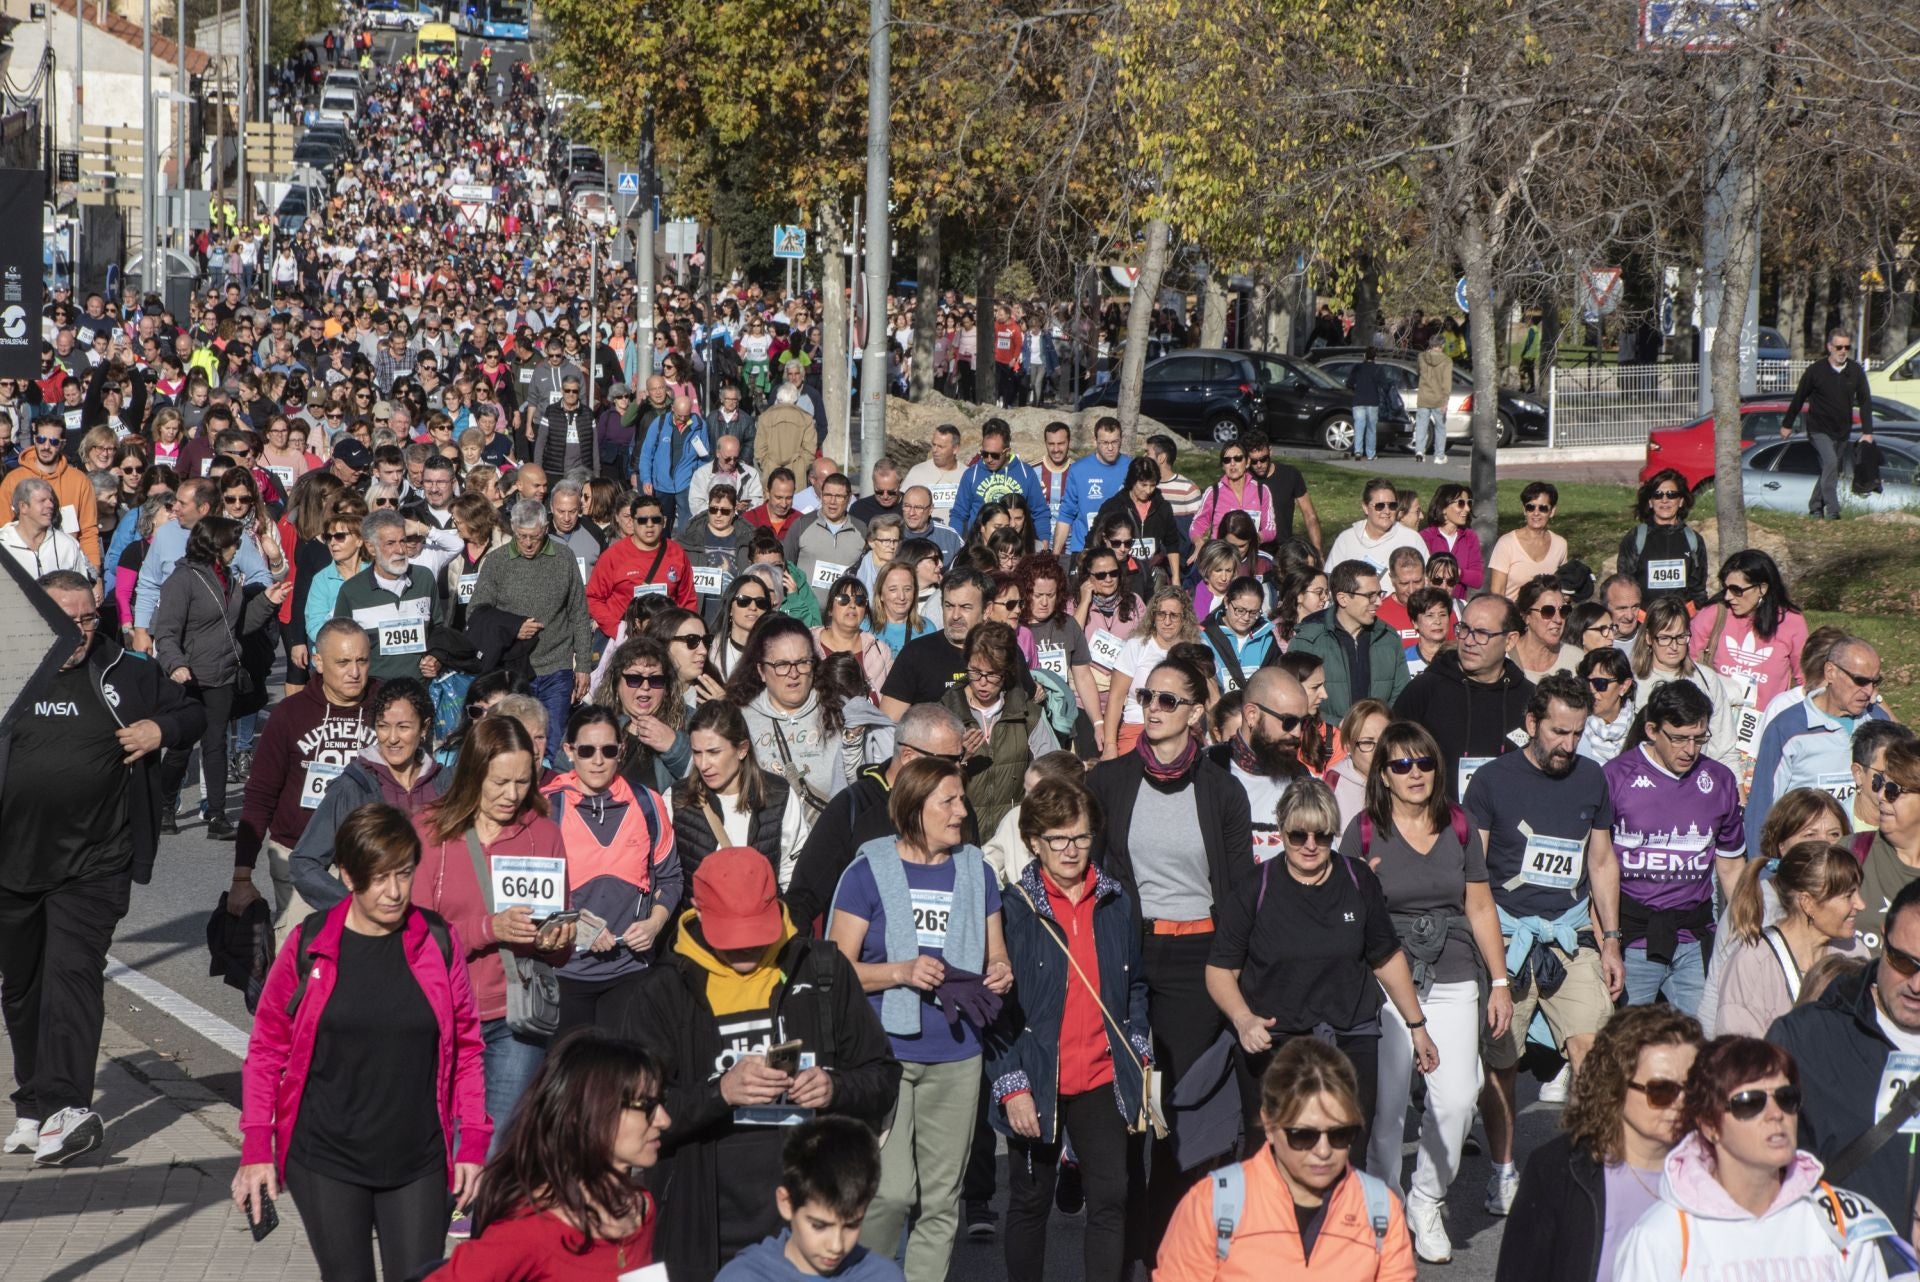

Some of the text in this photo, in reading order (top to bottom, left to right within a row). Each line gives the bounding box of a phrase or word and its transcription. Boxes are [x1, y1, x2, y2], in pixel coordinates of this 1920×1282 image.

[933, 491, 956, 501] 6755
[694, 575, 715, 587] 2714
[1653, 568, 1680, 581] 4946
[460, 583, 476, 596] 26
[385, 629, 418, 646] 2994
[35, 701, 79, 717] NASA
[1738, 712, 1757, 744] 1098
[324, 741, 348, 749] DENIM
[1532, 852, 1573, 876] 4724
[1622, 850, 1710, 871] UEMC
[1623, 872, 1703, 880] UNIVERSIDA
[502, 876, 554, 899] 6640
